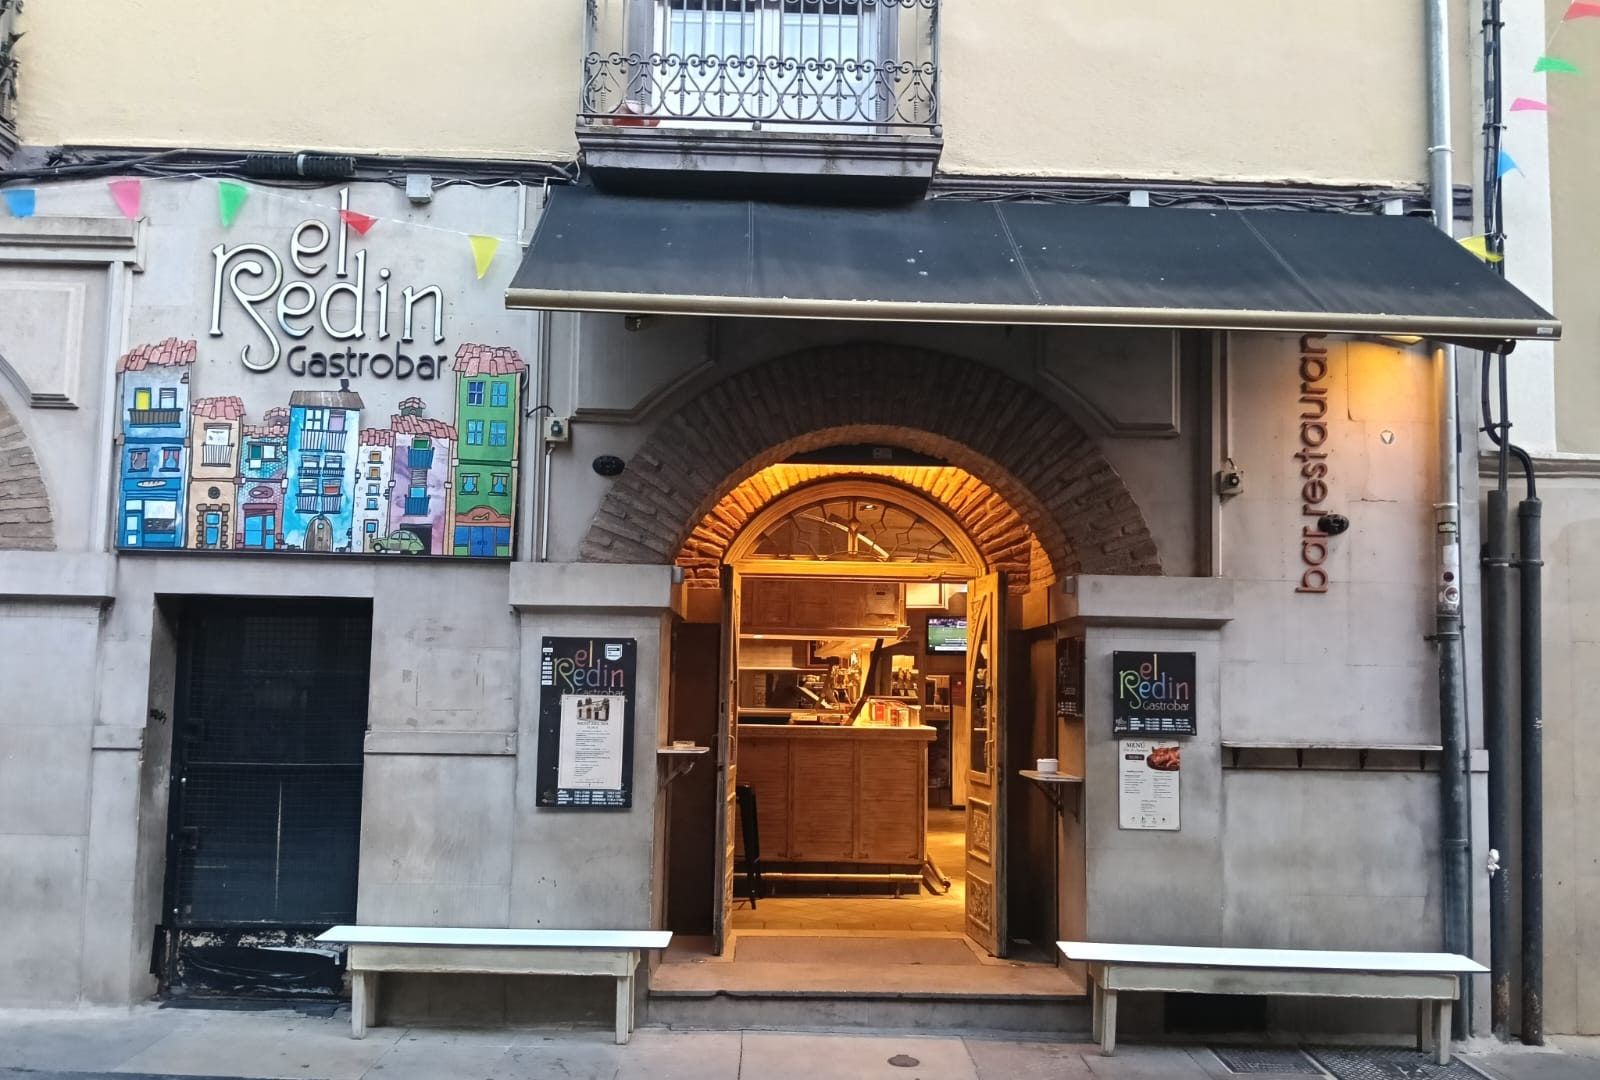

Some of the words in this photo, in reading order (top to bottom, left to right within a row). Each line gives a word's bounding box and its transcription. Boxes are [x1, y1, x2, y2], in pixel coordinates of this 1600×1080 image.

[290, 186, 350, 278] el
[208, 243, 446, 374] Redin
[287, 341, 448, 380] Gastrobar
[1294, 332, 1329, 516] restauran
[1295, 525, 1329, 594] bar
[574, 640, 593, 668] el
[1140, 653, 1158, 681] el
[553, 657, 625, 695] Redin
[1119, 671, 1189, 710] Redin
[1142, 700, 1190, 711] Gastrobar
